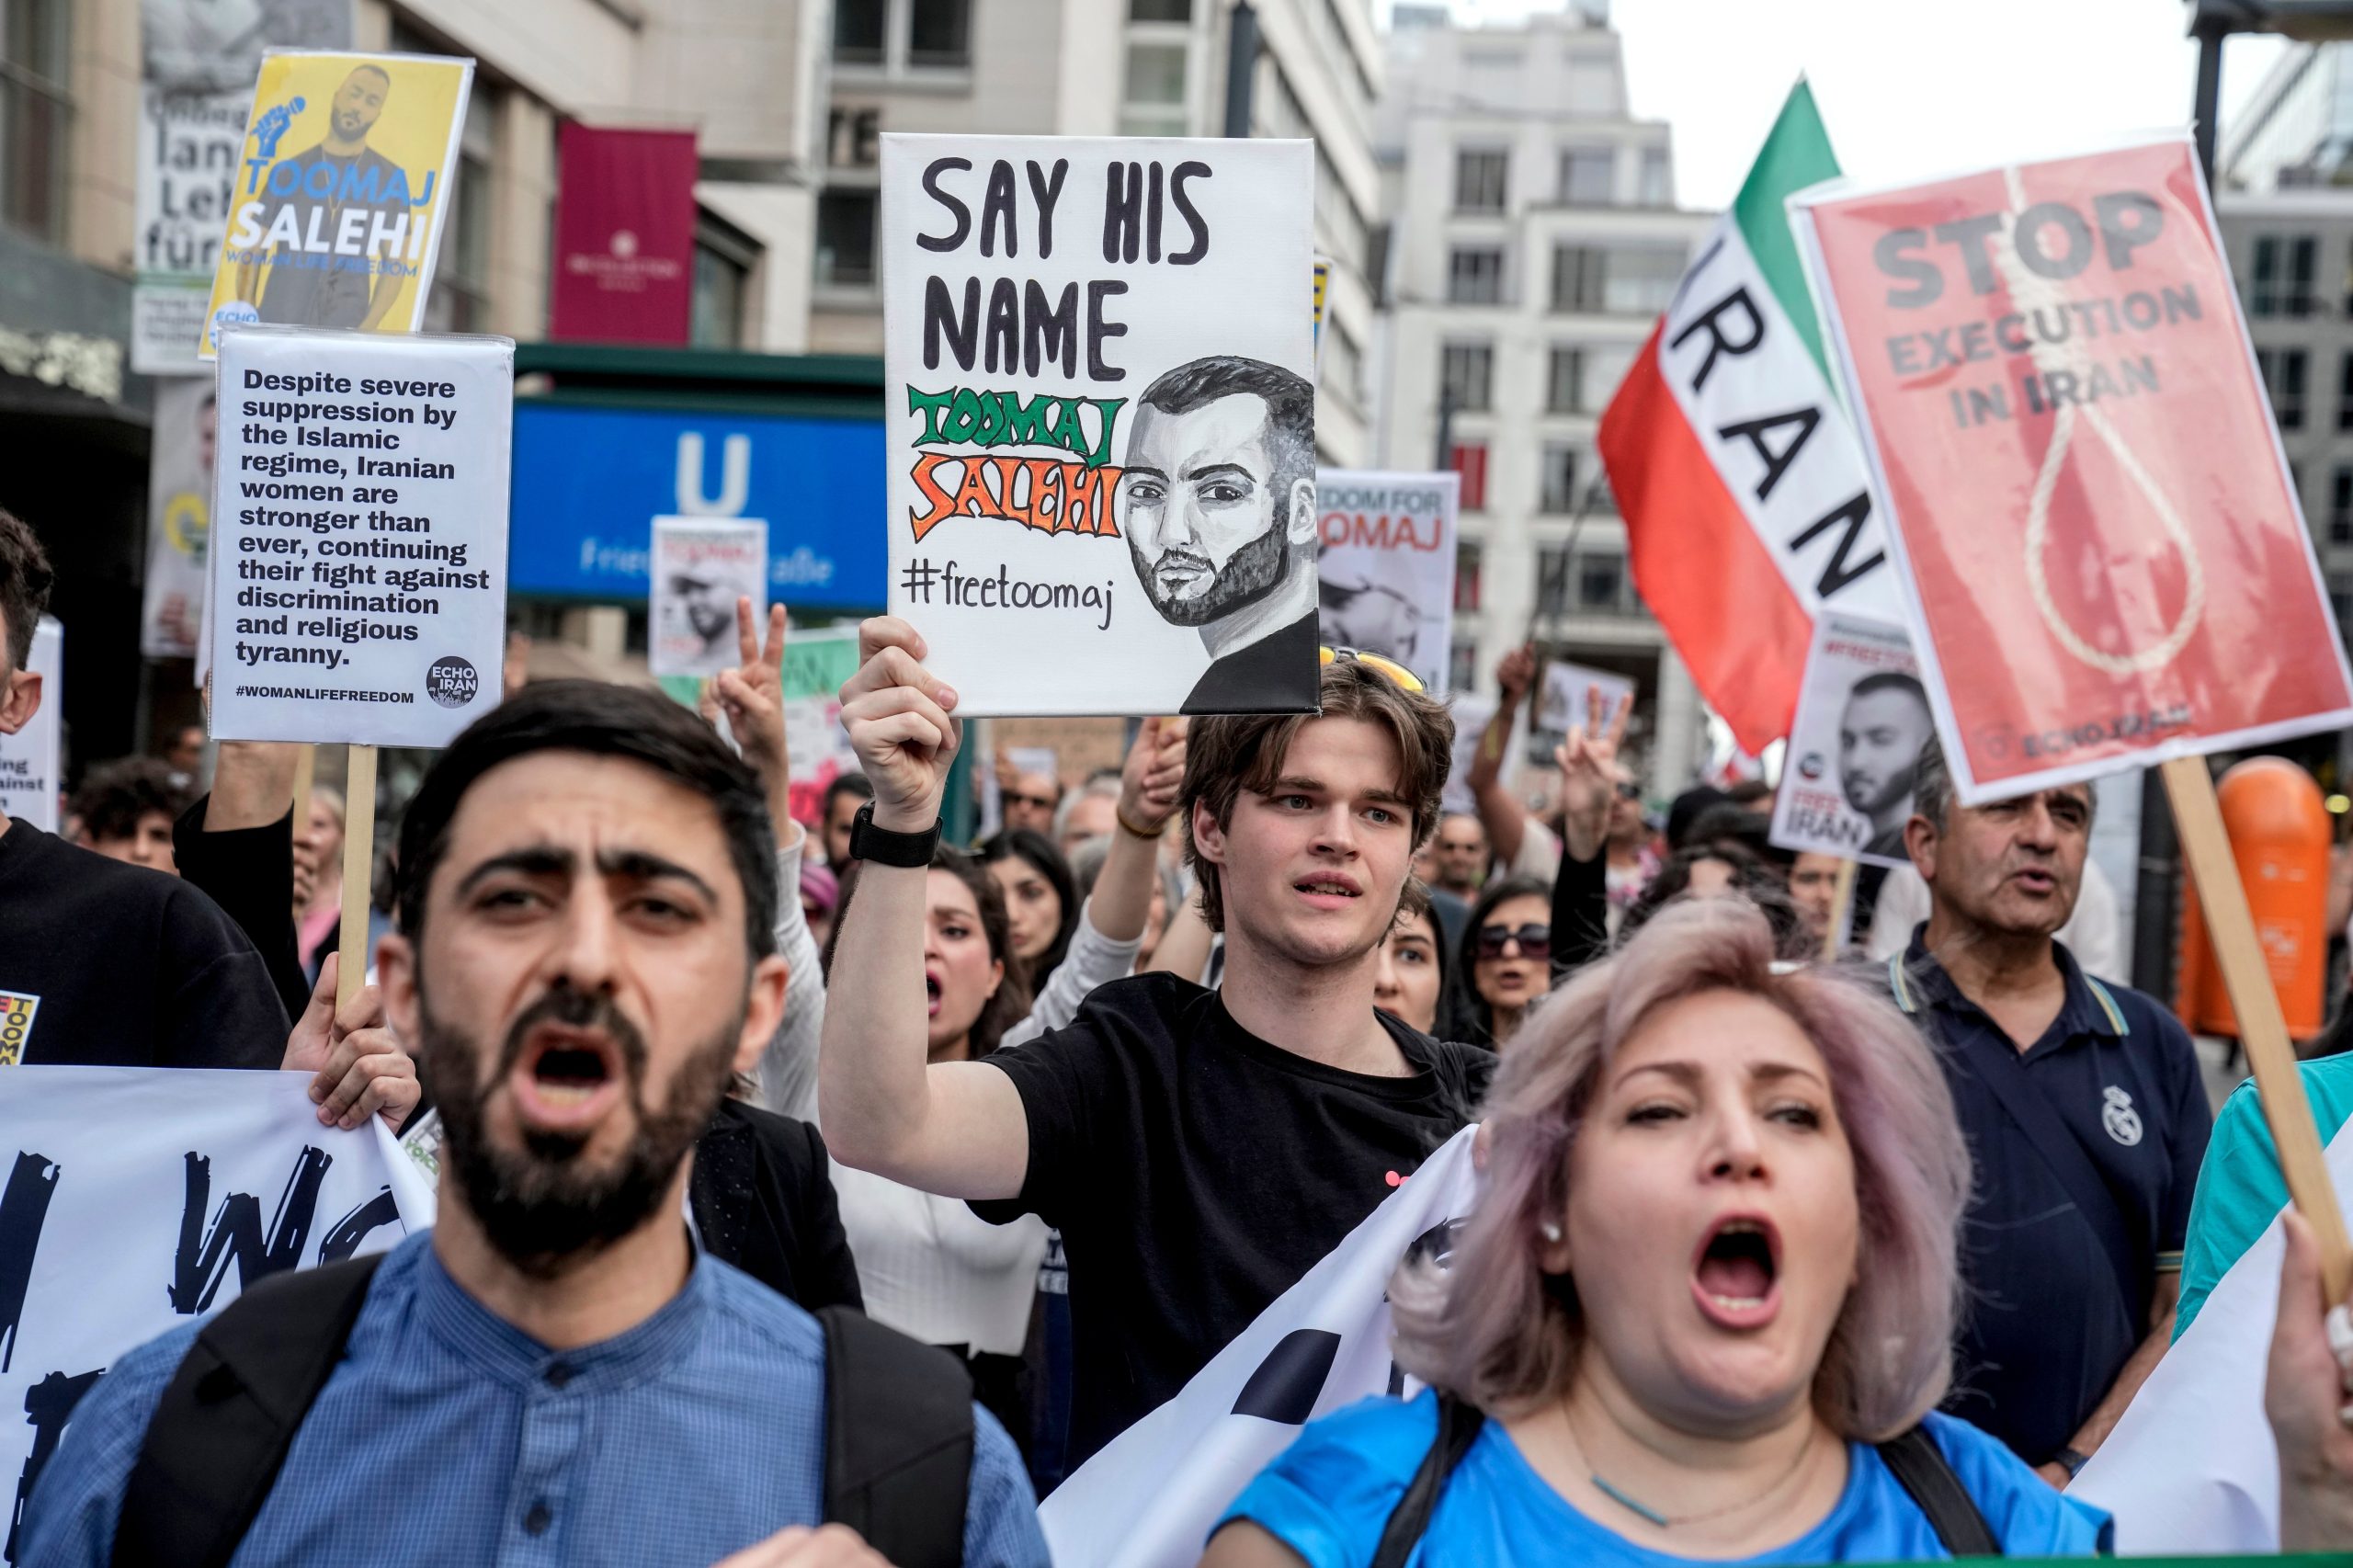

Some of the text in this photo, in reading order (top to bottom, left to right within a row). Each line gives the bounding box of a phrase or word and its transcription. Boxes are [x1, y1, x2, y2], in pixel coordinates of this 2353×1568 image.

[246, 158, 437, 208] TOOMAJ
[916, 157, 1212, 265] SAY HIS
[229, 200, 427, 262] SALEHI
[226, 250, 418, 278] WOMAN LIFE FREEDOM
[1872, 190, 2165, 310] STOP
[924, 276, 1128, 381] NAME
[1886, 283, 2204, 377] EXECUTION
[244, 369, 456, 399] Despite severe
[1949, 355, 2161, 430] IN IRAN
[243, 401, 458, 430] suppression by
[906, 383, 1130, 472] TOOMAJ
[242, 424, 400, 449] the Islamic
[242, 452, 454, 480] regime, Iranian
[676, 430, 752, 517] U
[240, 483, 398, 505] women are
[908, 450, 1126, 545] SALEHI
[1391, 490, 1442, 515] FOR
[239, 506, 430, 533] stronger than
[1317, 511, 1443, 552] OMAJ
[239, 537, 467, 566] ever, continuing
[238, 559, 489, 593] their fight against
[237, 586, 438, 614] discrimination
[901, 559, 1114, 631] #freetoomaj
[236, 615, 418, 643] and religious
[236, 642, 349, 669] tyranny.
[432, 666, 475, 679] ECHO
[439, 678, 476, 691] IRAN
[235, 685, 415, 704] #WOMANLIFEFREEDOM
